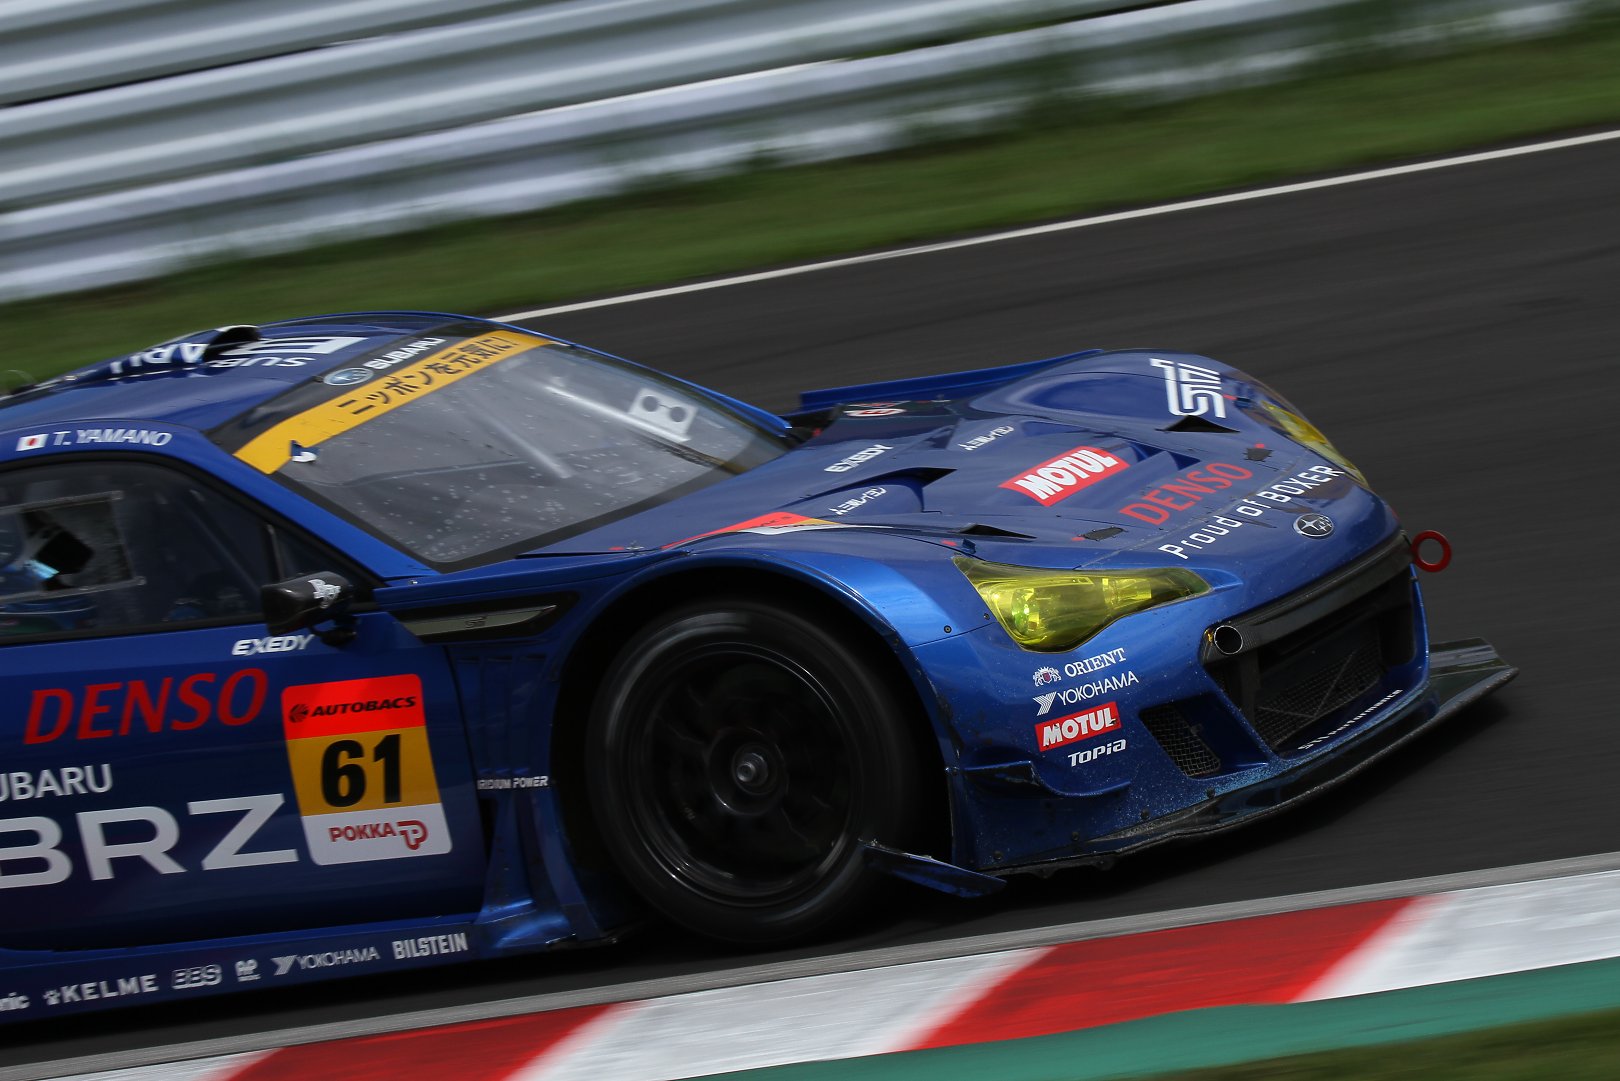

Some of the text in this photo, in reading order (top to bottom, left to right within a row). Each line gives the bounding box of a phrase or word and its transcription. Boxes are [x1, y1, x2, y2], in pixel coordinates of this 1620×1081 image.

[363, 337, 447, 370] SUBARU
[53, 428, 173, 446] T. YAMANO
[824, 444, 894, 473] EXEDY
[1014, 449, 1119, 501] MOTUL
[1119, 462, 1253, 526] DENSO
[1158, 465, 1345, 560] Proud of BOXER
[231, 634, 315, 656] EXEDY
[1064, 647, 1127, 678] ORIENT
[1057, 671, 1140, 706] YOKOHAMA
[23, 667, 269, 745] DENSO
[311, 696, 417, 718] AUTOBACS
[1043, 707, 1117, 747] MOTUL
[321, 733, 402, 808] 61
[512, 775, 549, 789] POWER
[0, 793, 299, 889] BRZ
[328, 822, 397, 843] POKKA
[298, 946, 381, 970] YOKOHAMA
[392, 932, 469, 960] BILSTEIN
[61, 974, 160, 1004] KELME
